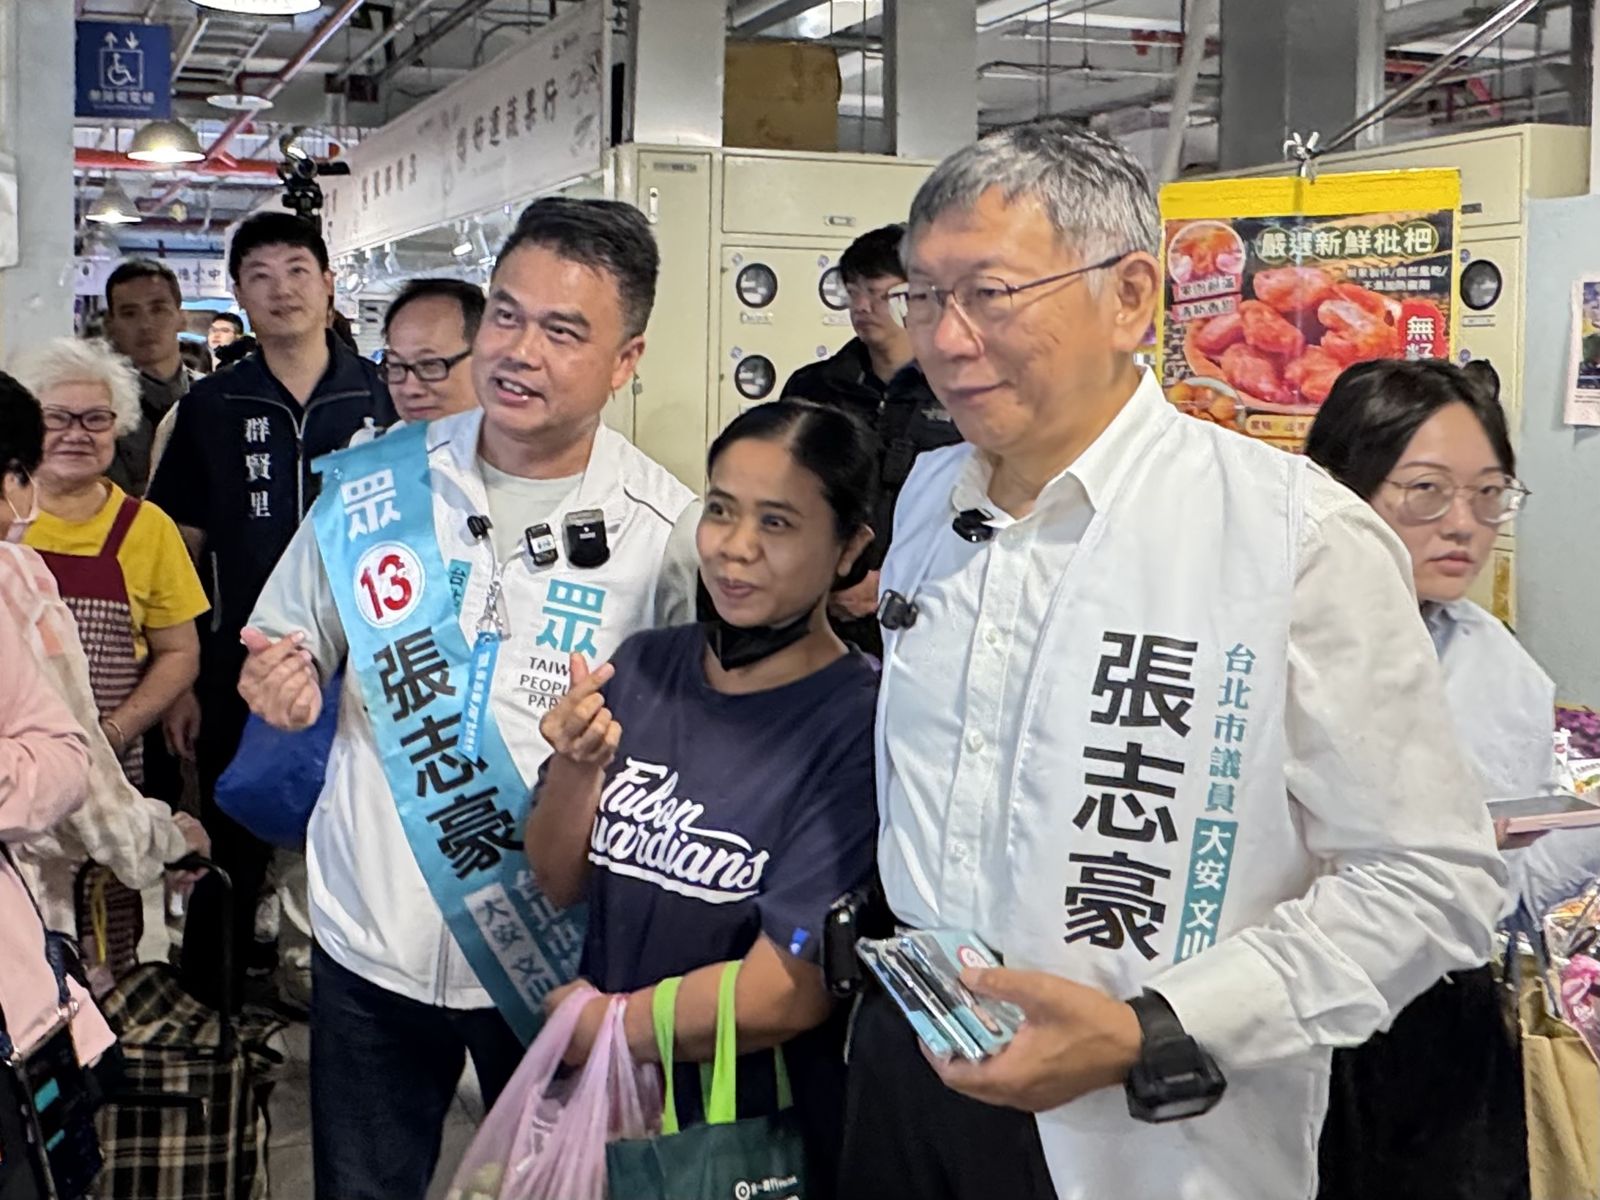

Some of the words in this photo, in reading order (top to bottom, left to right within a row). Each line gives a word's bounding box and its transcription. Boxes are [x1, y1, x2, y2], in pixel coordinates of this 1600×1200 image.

[1262, 226, 1432, 258] 嚴選新鮮枇杷
[244, 416, 272, 518] 群賢里
[341, 468, 401, 542] 眾
[360, 553, 413, 621] 13
[536, 578, 606, 660] 眾
[520, 674, 569, 697] PEOPL
[528, 694, 559, 711] PAR
[529, 656, 569, 677] TAIW
[373, 626, 524, 880] 張志豪
[1204, 642, 1257, 815] 台北市議員
[600, 757, 727, 846] Fubon
[1064, 630, 1199, 961] 張志豪
[589, 815, 770, 889] uardians
